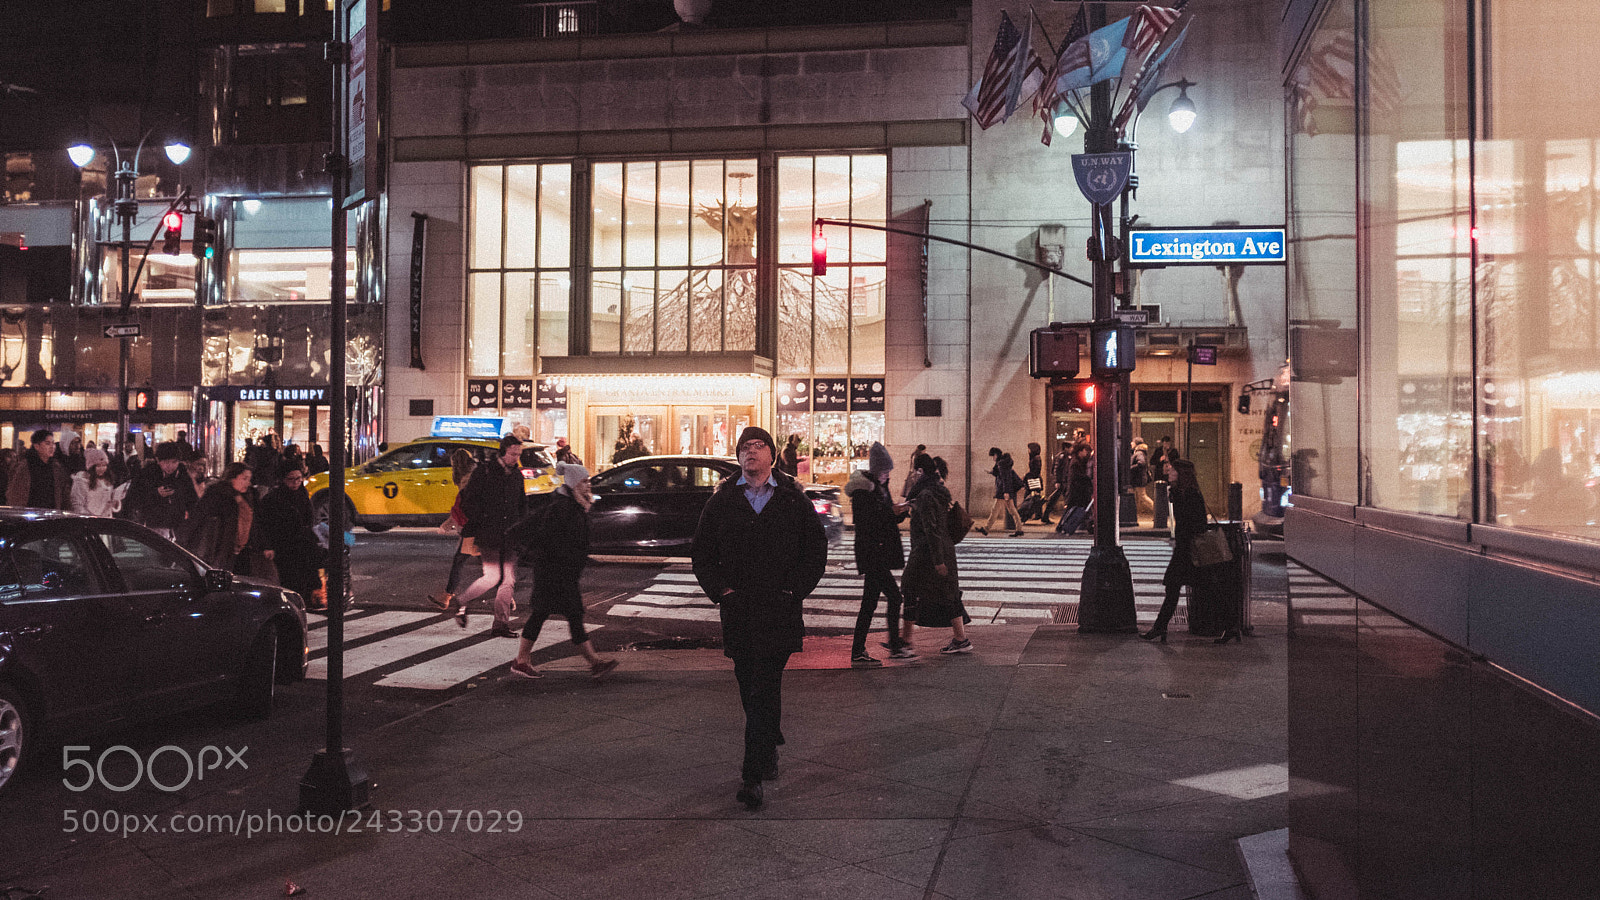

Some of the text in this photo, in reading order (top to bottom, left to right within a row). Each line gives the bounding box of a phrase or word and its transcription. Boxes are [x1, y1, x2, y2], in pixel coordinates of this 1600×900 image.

[1101, 156, 1124, 166] WAY
[1135, 238, 1280, 259] Lexington Ave
[412, 238, 422, 333] MARKET
[240, 389, 325, 400] CAFE GRUMPY
